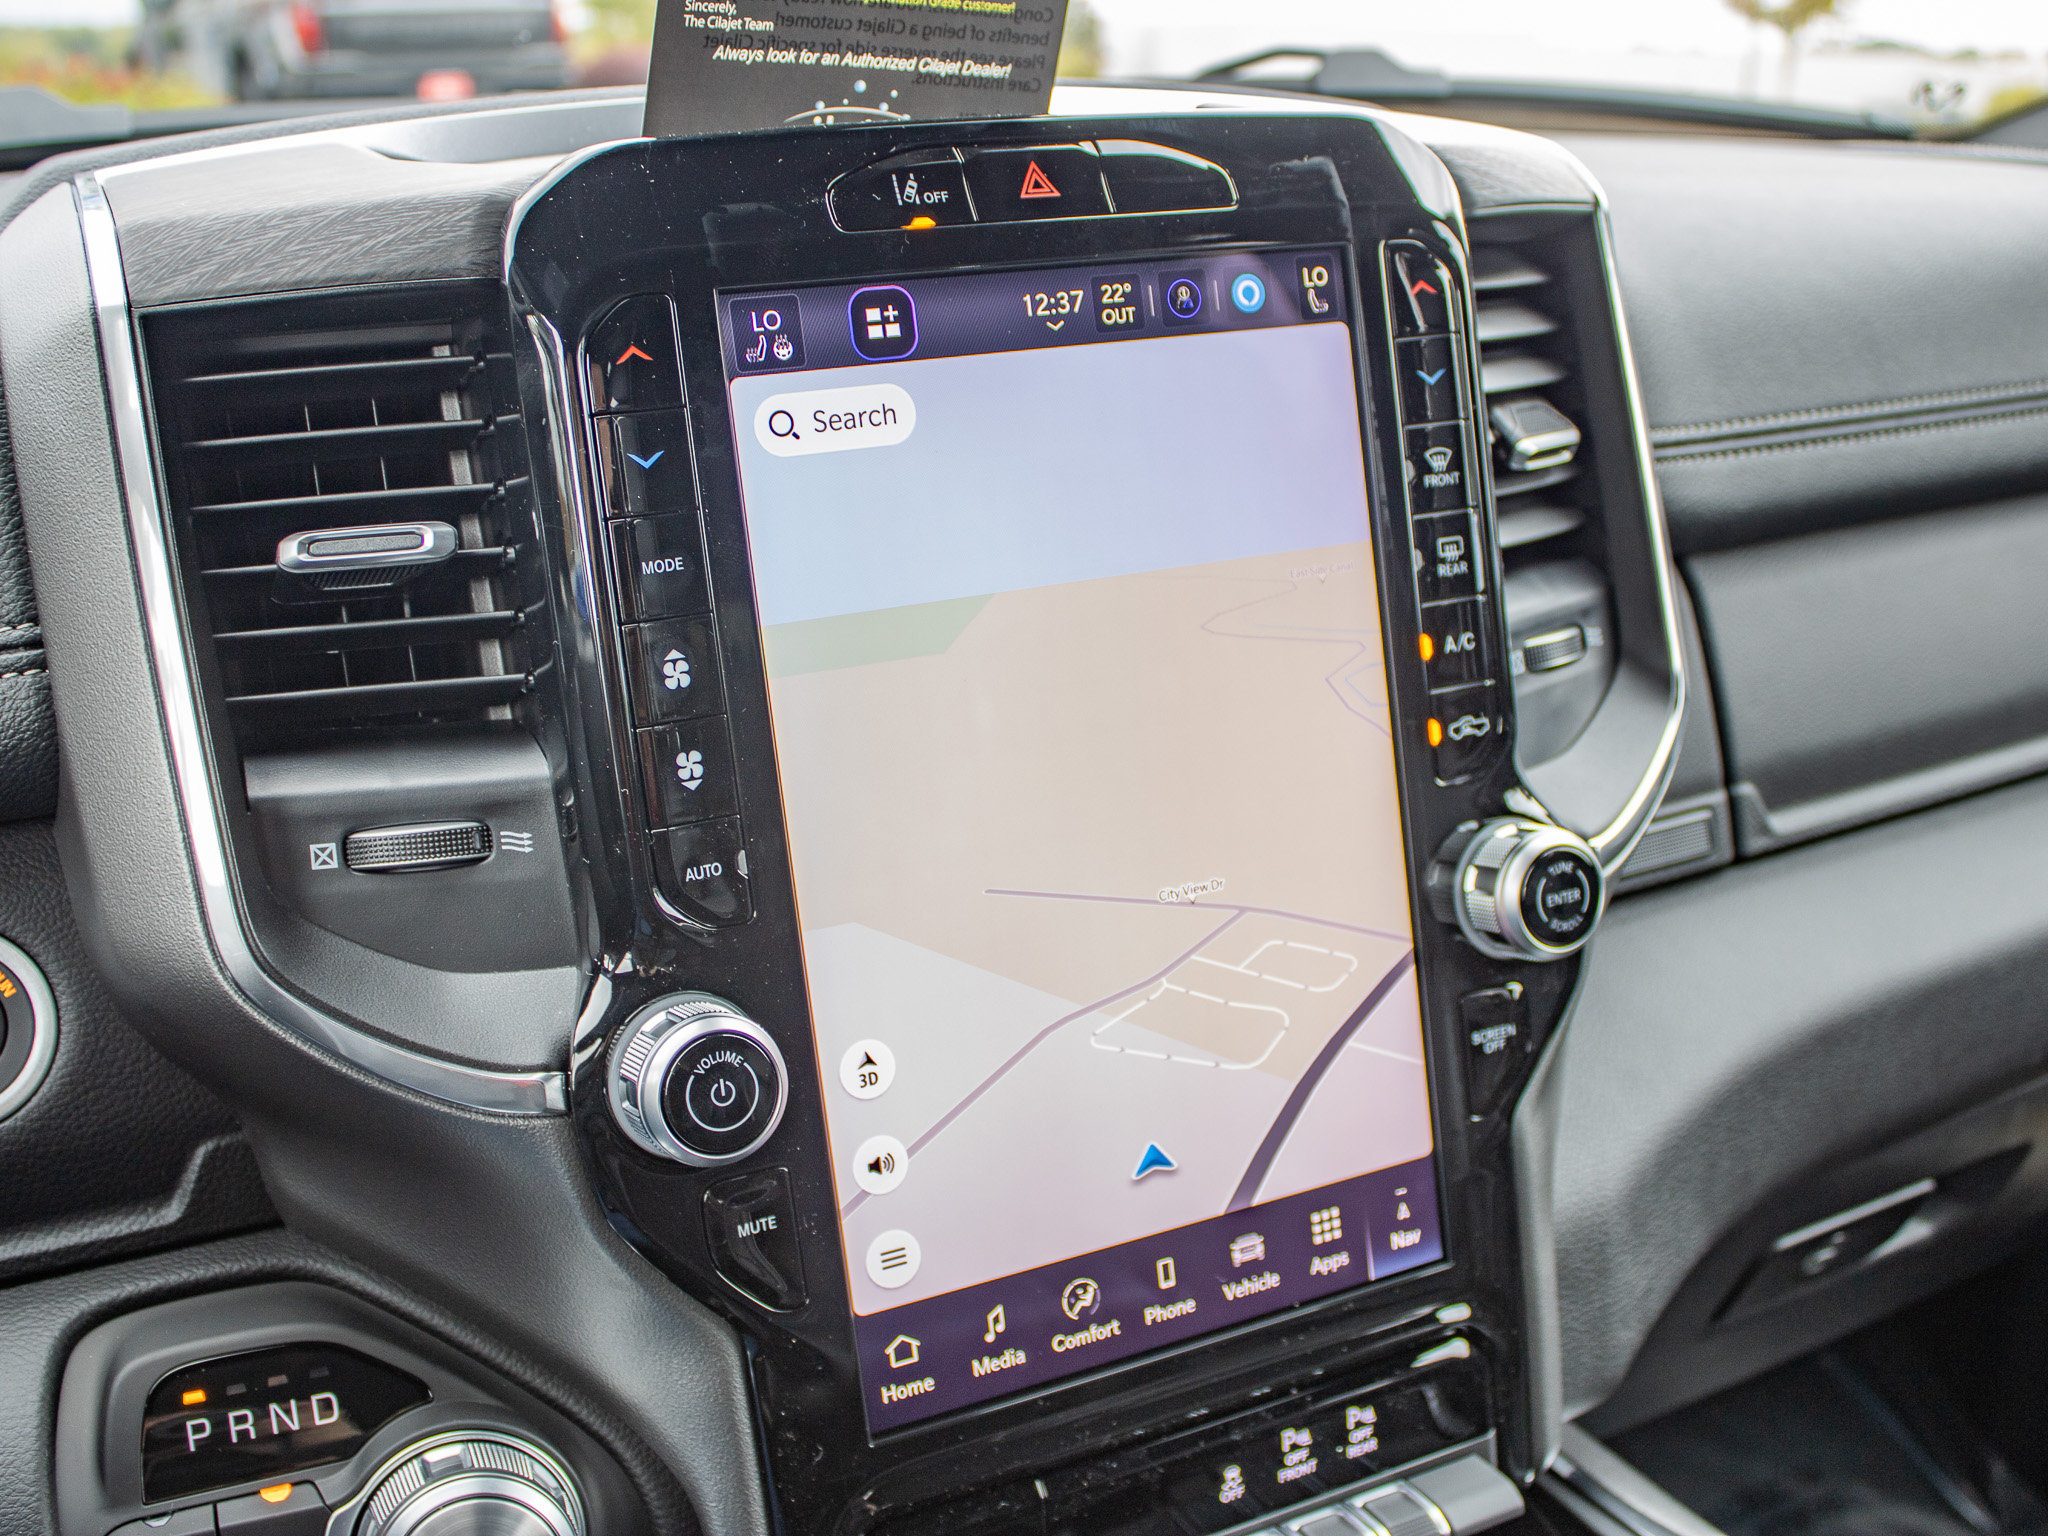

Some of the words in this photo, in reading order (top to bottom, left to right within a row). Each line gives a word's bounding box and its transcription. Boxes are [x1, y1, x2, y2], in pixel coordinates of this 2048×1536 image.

[684, 0, 736, 16] Sincerely,
[962, 0, 1016, 14] customer!
[684, 14, 706, 28] The
[707, 16, 742, 32] Cilajet
[744, 18, 774, 32] Team
[712, 45, 764, 65] Always
[766, 47, 798, 64] look
[799, 49, 820, 64] for
[821, 53, 840, 66] an
[841, 52, 917, 72] Authorized
[918, 58, 960, 78] Cilajet
[961, 60, 1012, 78] Dealer!
[924, 190, 948, 204] OFF
[1302, 266, 1328, 288] LO
[1023, 290, 1084, 318] 12:37
[751, 310, 782, 332] LO
[1102, 306, 1136, 326] OUT
[812, 402, 898, 434] Search
[1424, 471, 1460, 488] FRONT
[642, 556, 684, 574] MODE
[1437, 560, 1468, 577] REAR
[1444, 632, 1476, 654] A/C
[686, 862, 722, 880] AUTO
[1548, 861, 1574, 876] TUNE
[1158, 890, 1180, 902] City
[1183, 884, 1208, 896] View
[1211, 878, 1224, 890] Dr
[1546, 887, 1581, 908] ENTER
[1470, 1023, 1516, 1046] SCREEN
[1482, 1038, 1506, 1054] OFF
[694, 1050, 744, 1074] VOLUME
[858, 1071, 878, 1088] 3D
[737, 1216, 778, 1238] MUTE
[1390, 1226, 1422, 1251] Nav
[1310, 1250, 1350, 1277] Apps
[1222, 1270, 1281, 1302] Vehicle
[1144, 1298, 1196, 1327] Phone
[1051, 1319, 1121, 1354] Comfort
[972, 1348, 1026, 1378] Media
[880, 1375, 936, 1406] Home
[1348, 1424, 1374, 1444] OFF
[1284, 1447, 1310, 1466] OFF
[1346, 1436, 1378, 1460] REAR
[1277, 1458, 1318, 1484] FRONT
[1219, 1483, 1246, 1504] OFF
